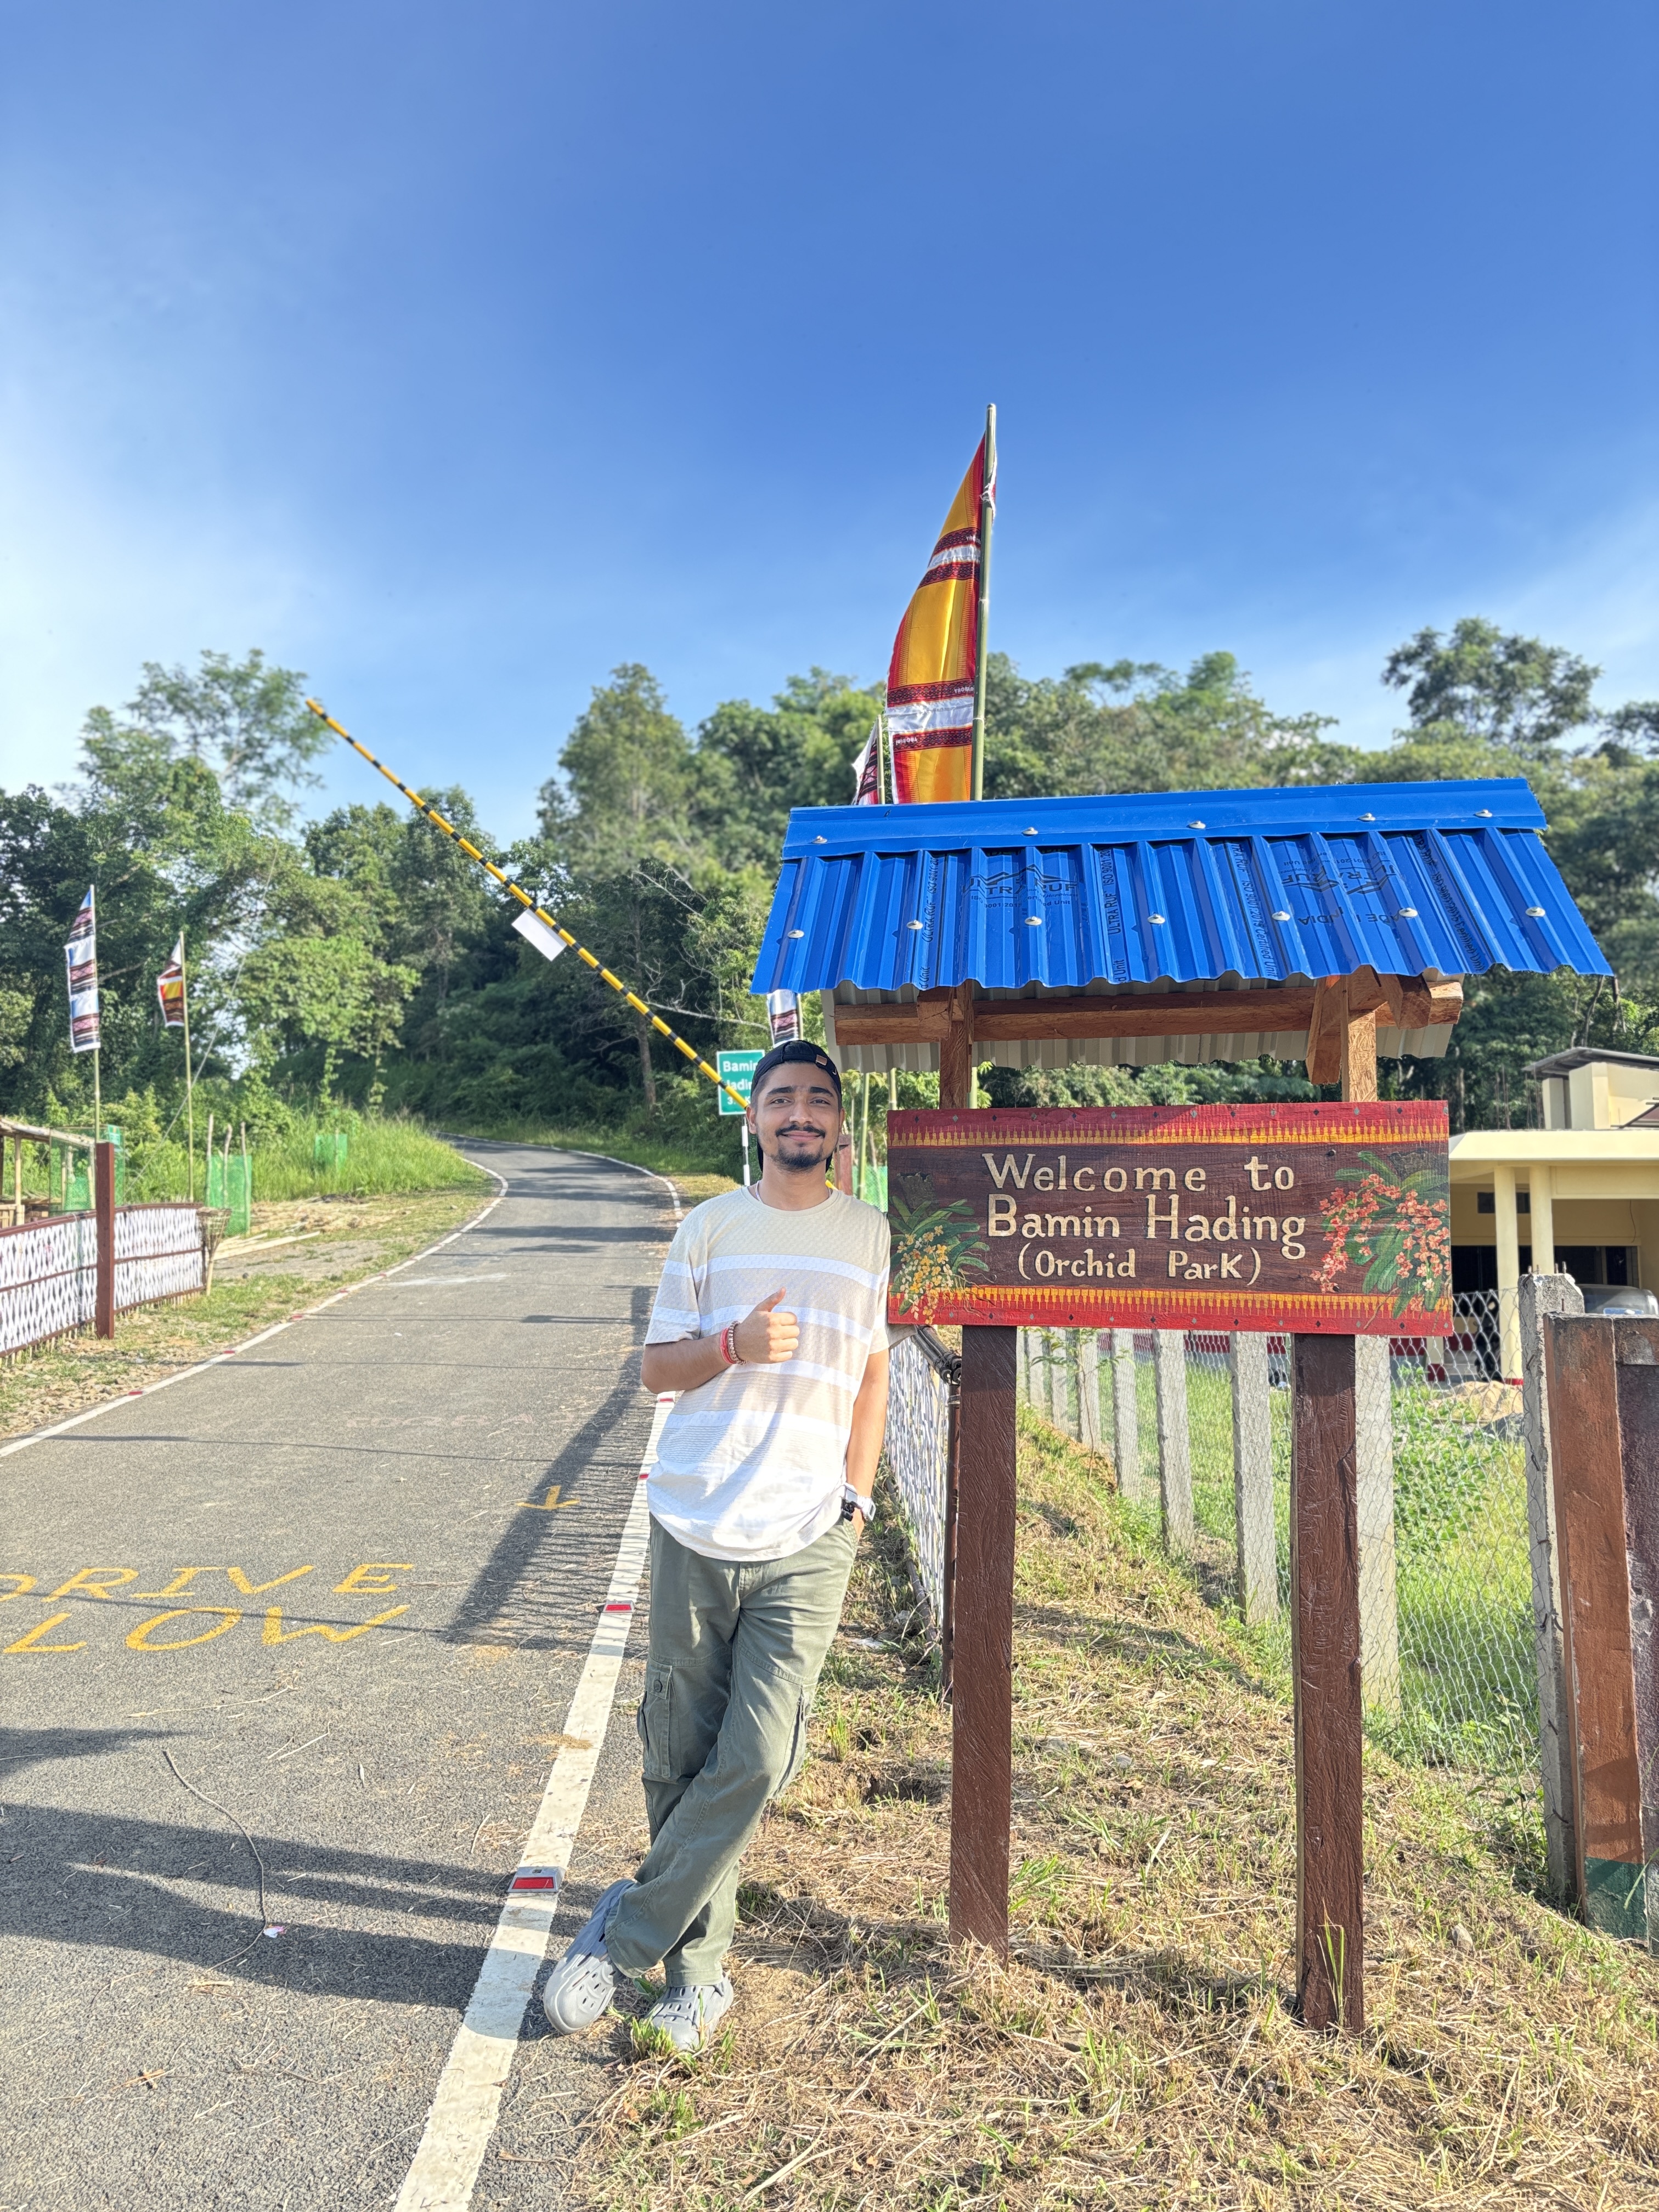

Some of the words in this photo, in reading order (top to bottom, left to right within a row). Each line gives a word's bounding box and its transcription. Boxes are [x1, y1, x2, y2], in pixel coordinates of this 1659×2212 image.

[1099, 847, 1113, 874] 9001:20
[1103, 873, 1115, 886] ISO
[921, 915, 935, 943] ULTRA
[1107, 909, 1121, 935] ULTRA
[1365, 909, 1400, 923] ADE
[1114, 959, 1127, 975] Unit
[1264, 957, 1279, 980] Unit
[982, 1153, 1206, 1192] Welcome
[1244, 1155, 1295, 1191] to
[988, 1193, 1120, 1238] Bamin
[1145, 1194, 1306, 1260] Hading
[1018, 1242, 1137, 1280] (Orchid
